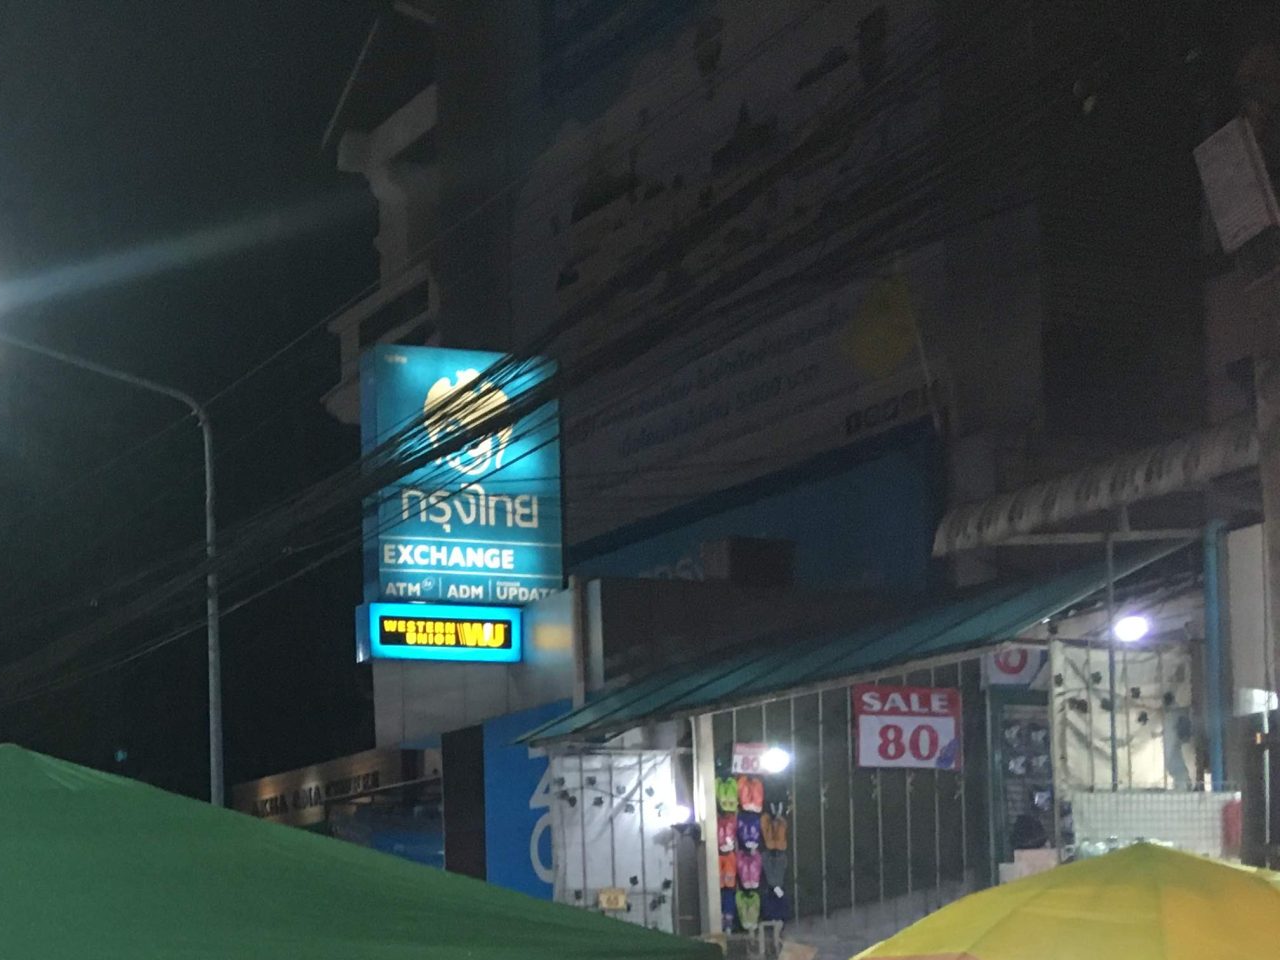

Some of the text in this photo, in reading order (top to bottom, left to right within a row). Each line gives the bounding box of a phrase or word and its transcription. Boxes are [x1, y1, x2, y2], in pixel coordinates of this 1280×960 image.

[401, 482, 540, 533] กรุงไทย
[383, 543, 515, 570] EXCHANGE
[385, 581, 421, 598] ATM
[447, 584, 484, 599] ADM
[383, 619, 456, 632] WESTERN
[462, 622, 505, 648] WU
[405, 632, 456, 645] UNION
[861, 691, 949, 714] SALE
[877, 724, 939, 761] 80
